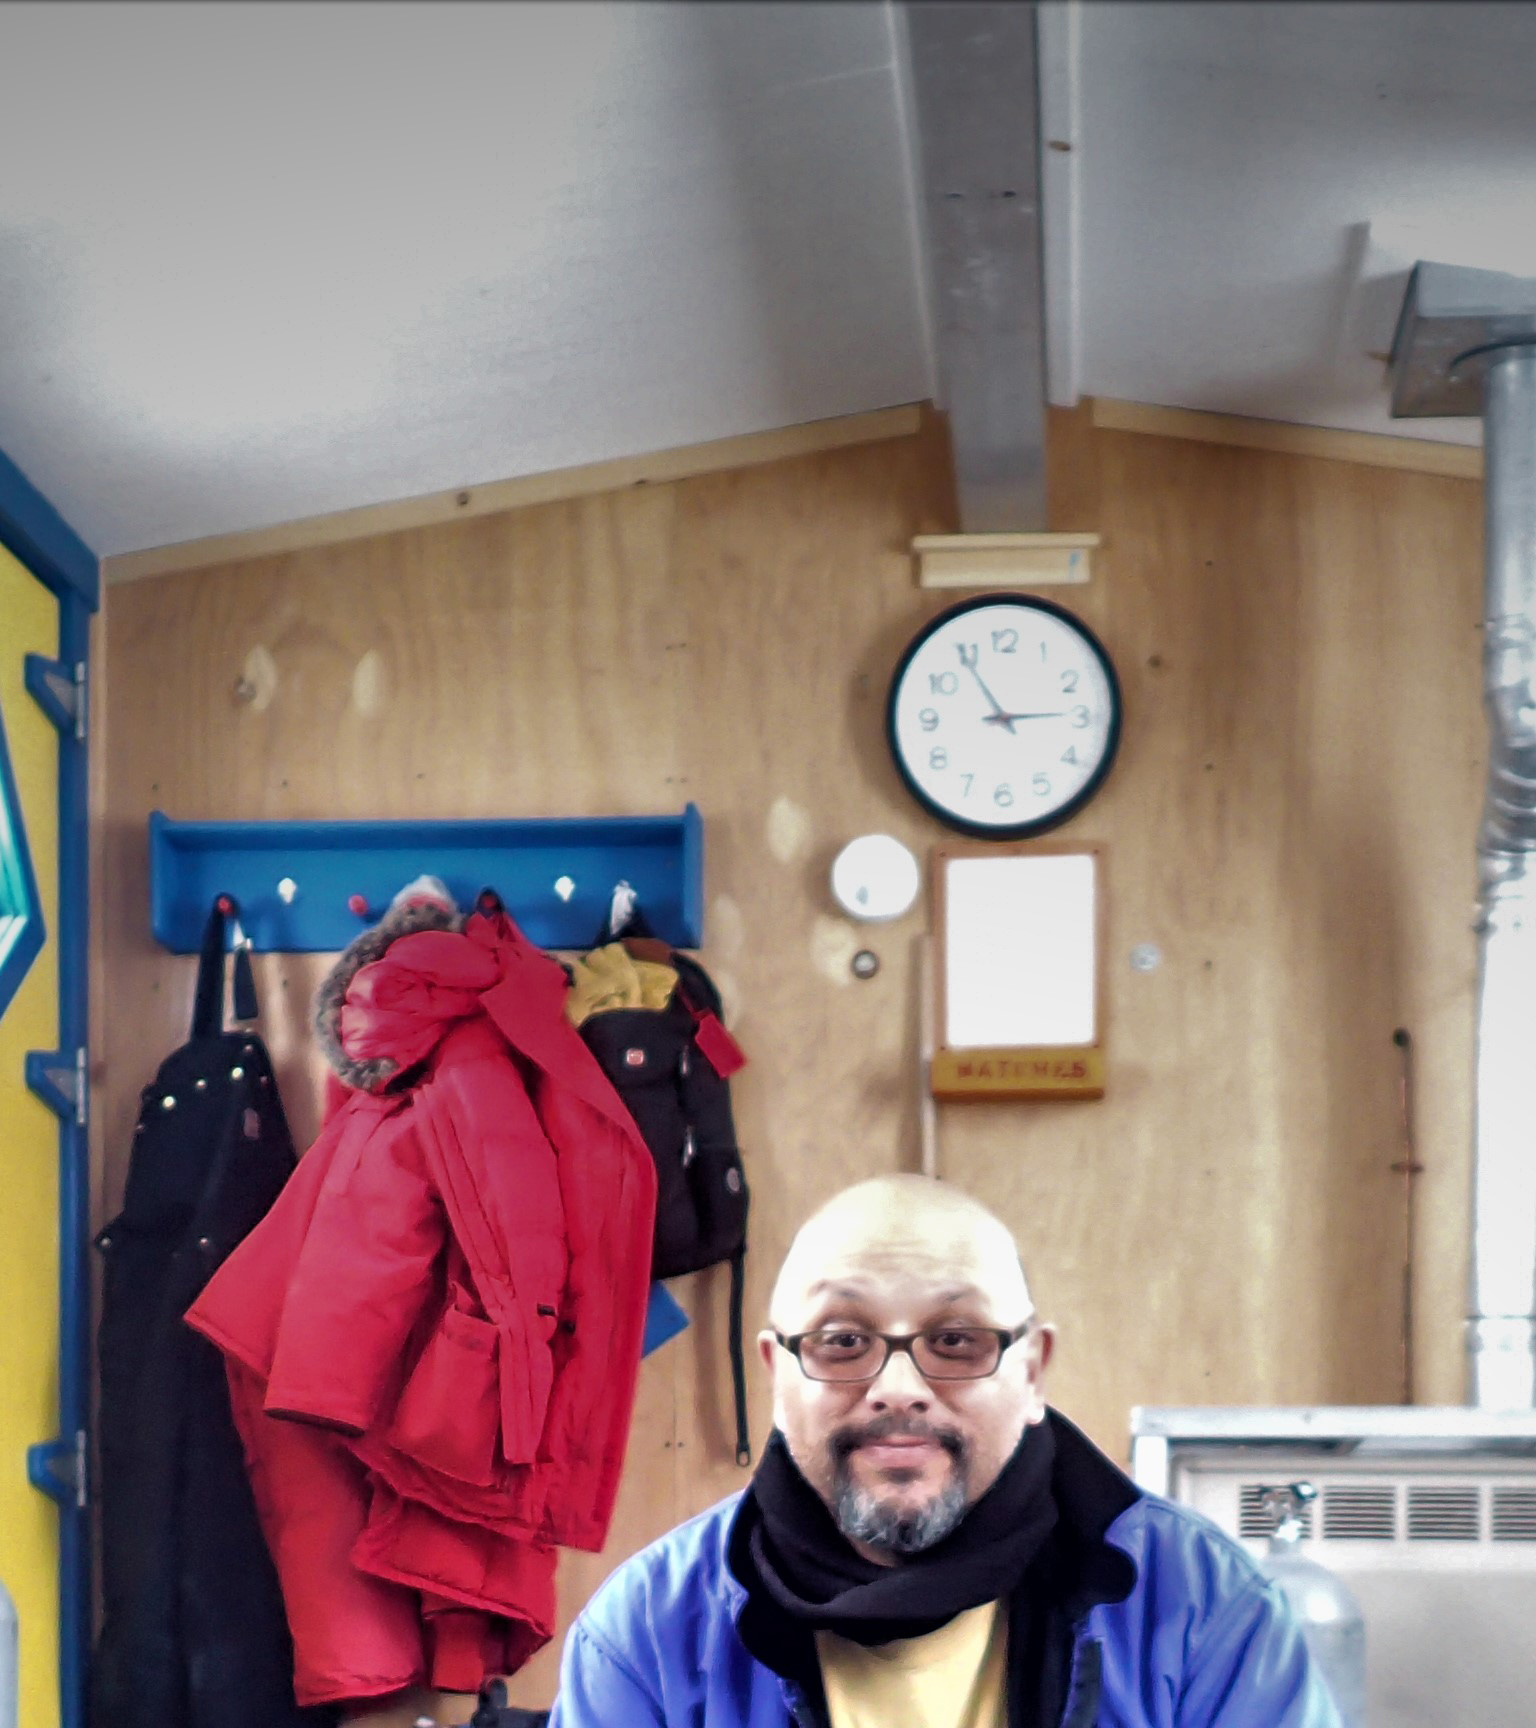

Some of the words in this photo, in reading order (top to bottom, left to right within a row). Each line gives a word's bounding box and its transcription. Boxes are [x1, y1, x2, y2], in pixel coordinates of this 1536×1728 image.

[991, 628, 1019, 653] 12
[1040, 641, 1047, 663] 1
[929, 671, 959, 695] 10
[1060, 669, 1080, 693] 2
[919, 708, 939, 731] 9
[1071, 705, 1090, 728] 3
[929, 746, 948, 770] 8
[1060, 745, 1078, 765] 4
[960, 773, 975, 797] 7
[993, 783, 1014, 807] 6
[1032, 772, 1051, 796] 5
